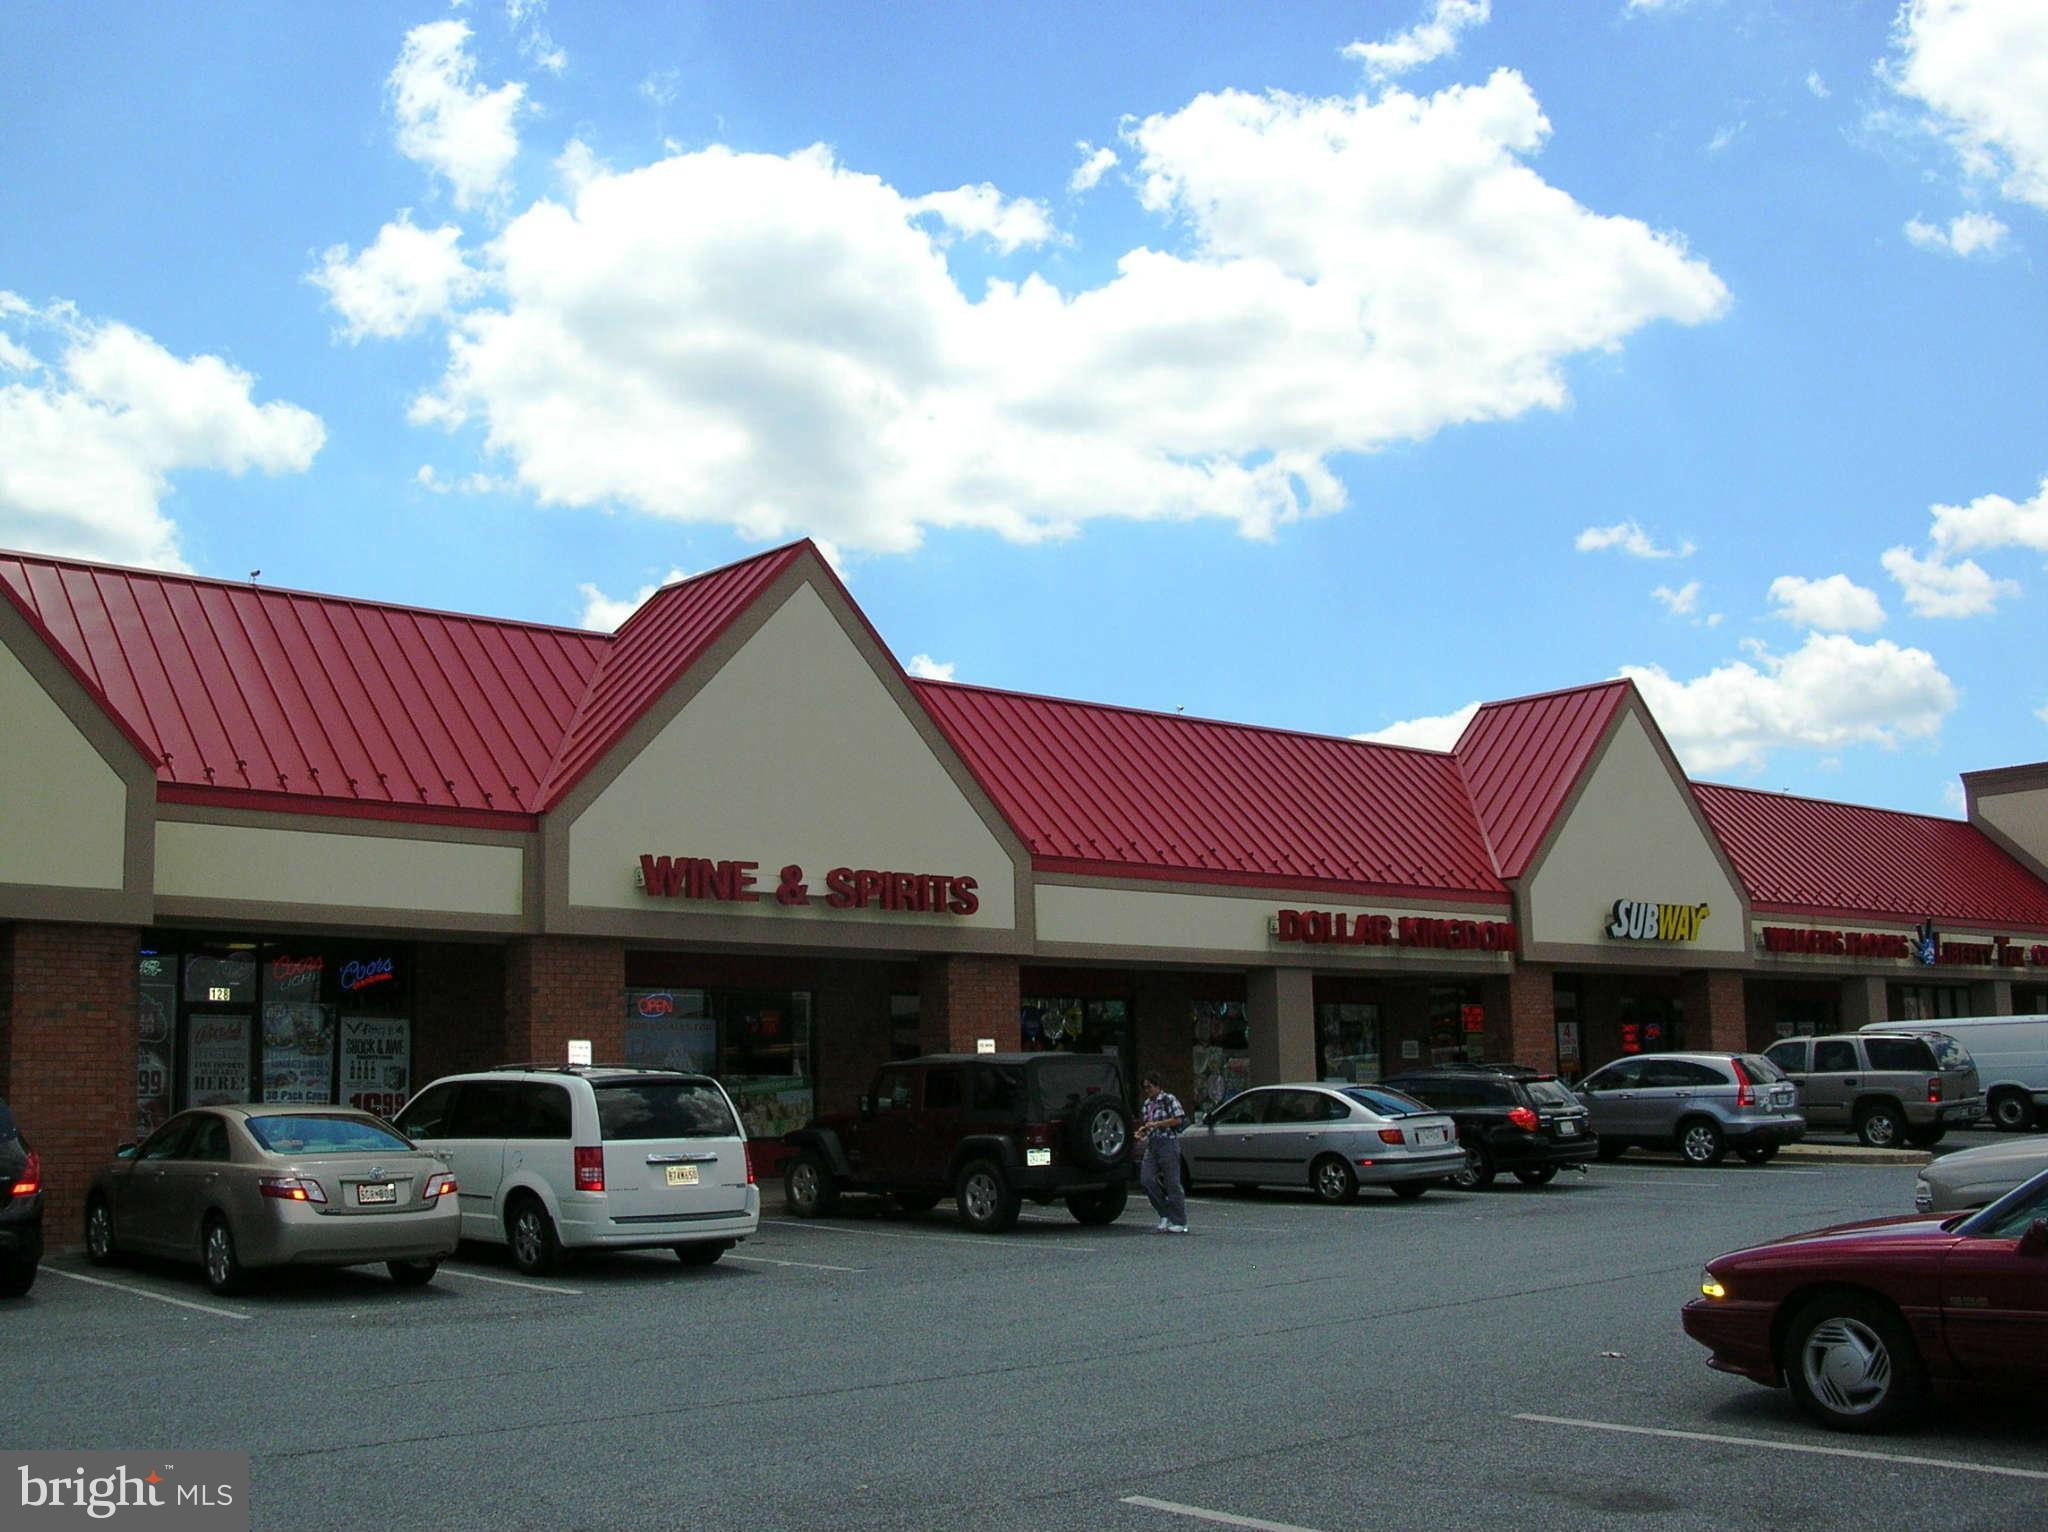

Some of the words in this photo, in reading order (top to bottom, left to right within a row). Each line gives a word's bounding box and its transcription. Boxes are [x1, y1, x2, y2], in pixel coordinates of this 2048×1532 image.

[640, 854, 759, 902] WINE
[776, 864, 809, 906] &
[825, 867, 980, 916] SPIRITS
[1278, 909, 1393, 947] DOLLAR
[1398, 916, 1519, 952] KINGDOM
[1609, 898, 1710, 942] SUBWAY
[340, 957, 393, 990] Coors
[212, 988, 229, 1000] 128
[639, 999, 673, 1013] OPEN
[193, 1076, 245, 1089] HERE!
